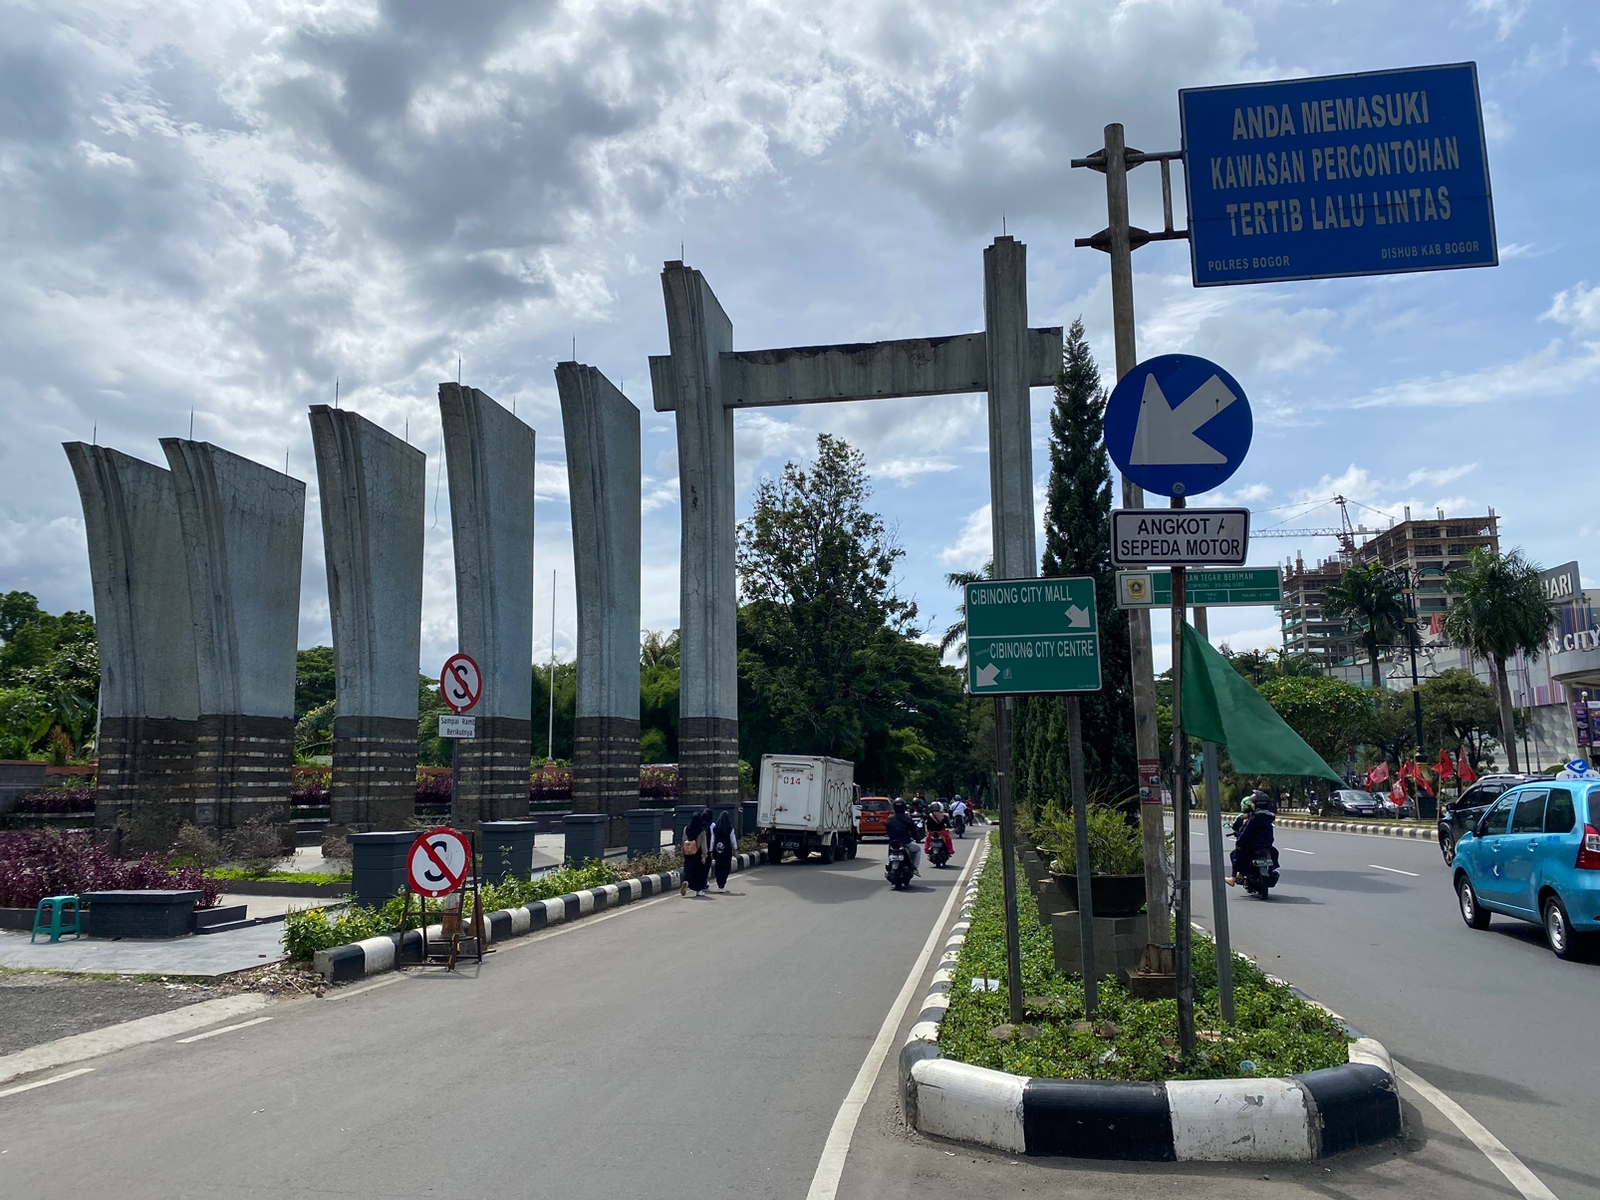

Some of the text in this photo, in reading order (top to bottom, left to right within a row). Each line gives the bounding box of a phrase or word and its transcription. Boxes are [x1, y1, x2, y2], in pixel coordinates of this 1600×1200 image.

[1232, 91, 1429, 140] ANDA MEMASUKI
[1211, 136, 1460, 190] KAWASAN PERCONTOHAN
[1226, 185, 1452, 237] TERTIB LALU LINTAS
[1381, 241, 1480, 259] DISHUB KAB BOGOR
[1208, 255, 1290, 271] POLRES BOGOR
[1137, 518, 1225, 535] ANGKOT /
[1121, 539, 1240, 556] SEPEDA MOTOR
[1186, 572, 1254, 582] LAN TEGAR BERIMAN
[970, 585, 1073, 605] CIBINONG CITY MALL
[990, 640, 1095, 659] CIBINONG CITY CENTRE
[440, 717, 459, 726] Sampai
[447, 728, 473, 737] Berikutnya
[783, 776, 801, 785] 014
